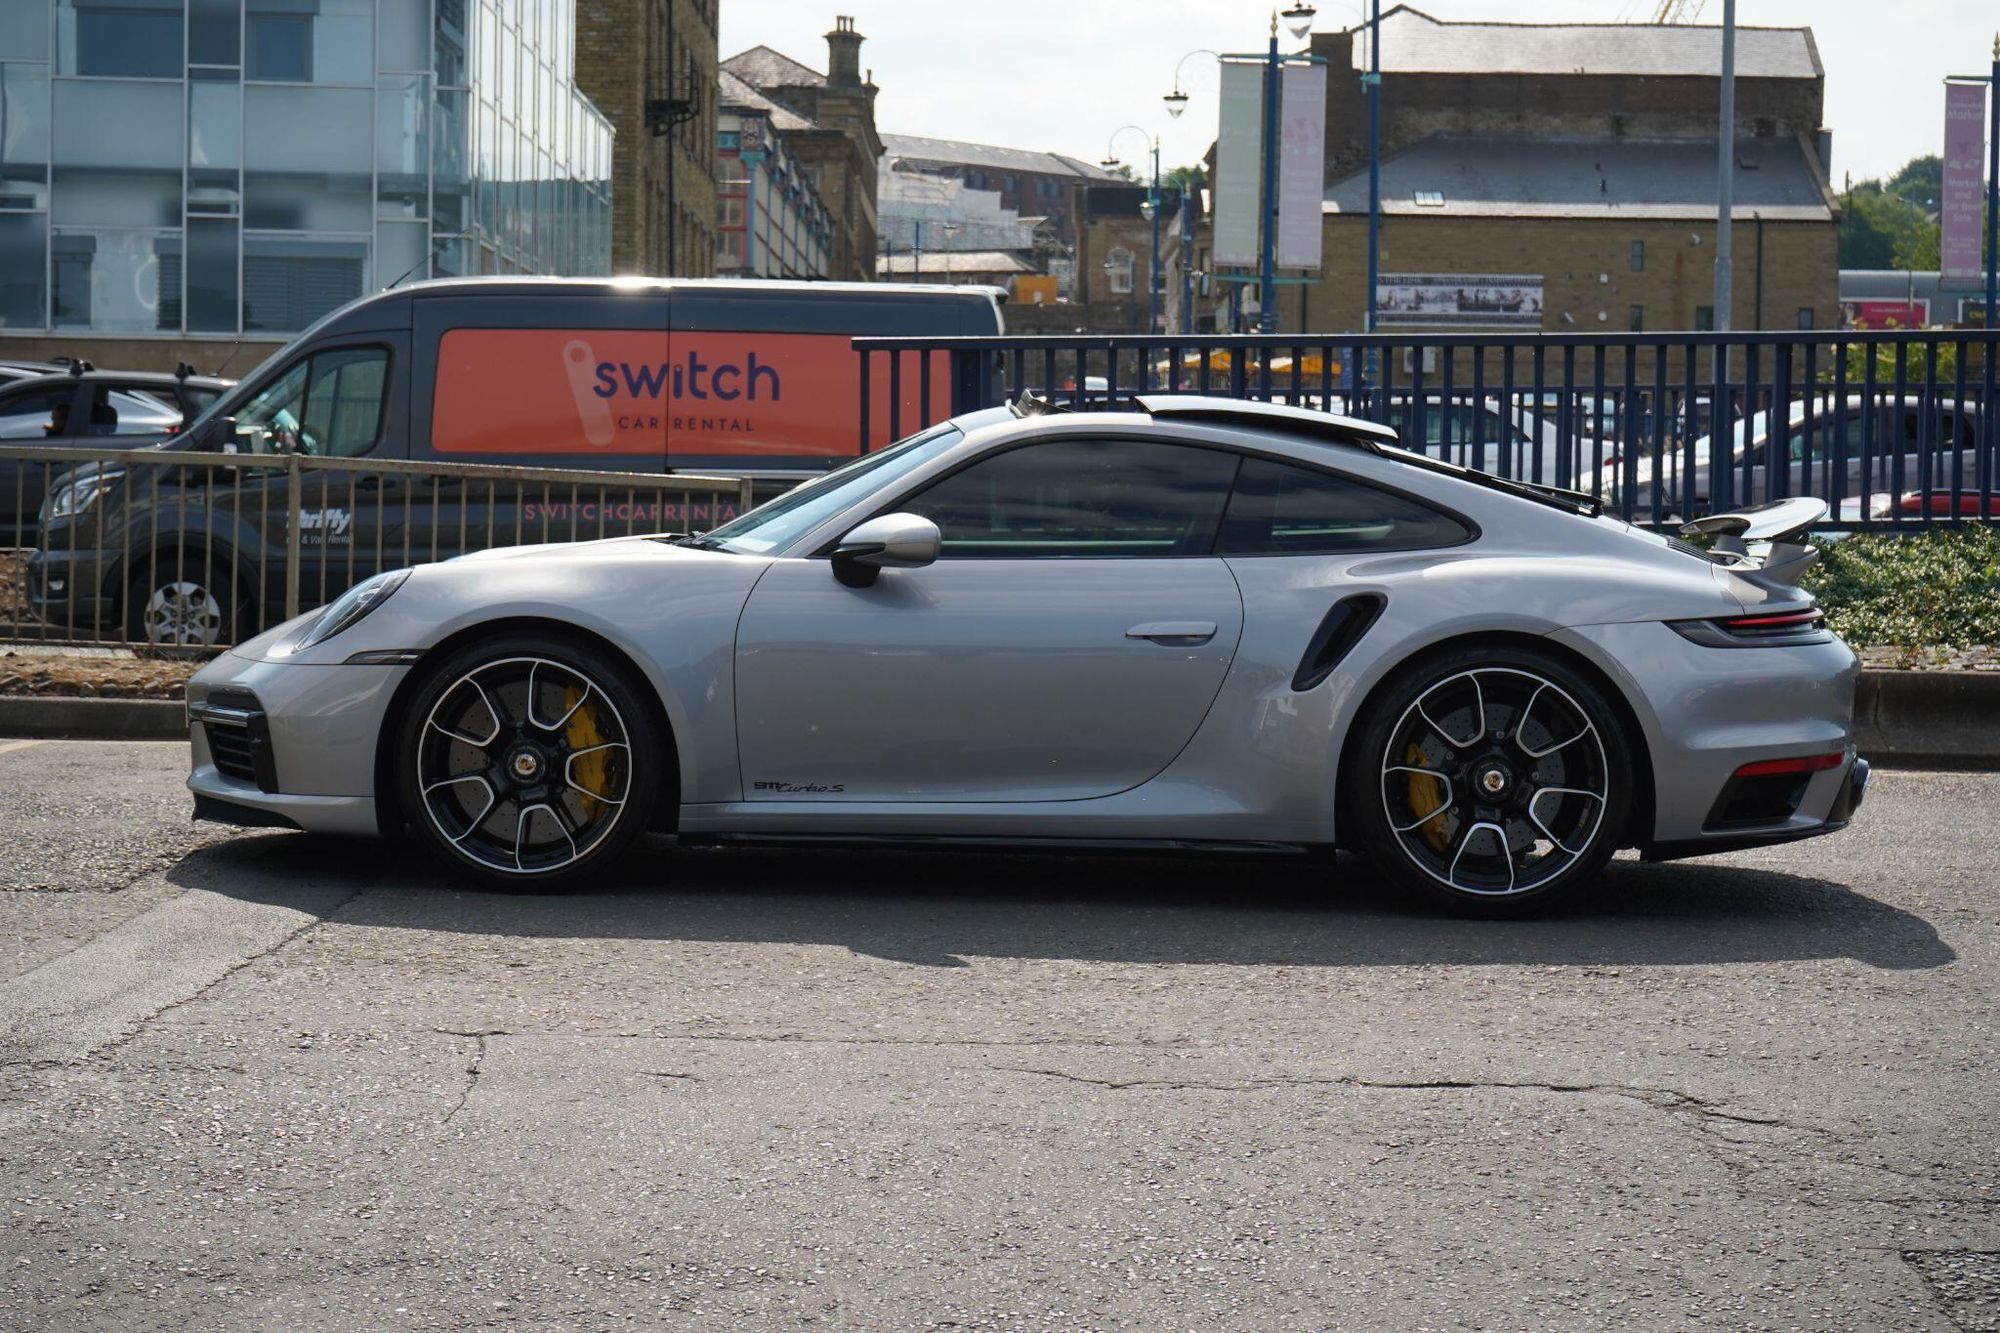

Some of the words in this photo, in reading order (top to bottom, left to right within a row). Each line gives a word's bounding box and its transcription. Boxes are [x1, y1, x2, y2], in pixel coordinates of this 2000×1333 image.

[593, 351, 780, 401] switch
[618, 416, 659, 430] CAR
[673, 417, 753, 432] RENTAL
[524, 503, 737, 520] SWICHCARRENTA
[286, 508, 351, 535] hrifty
[328, 535, 352, 545] Renta
